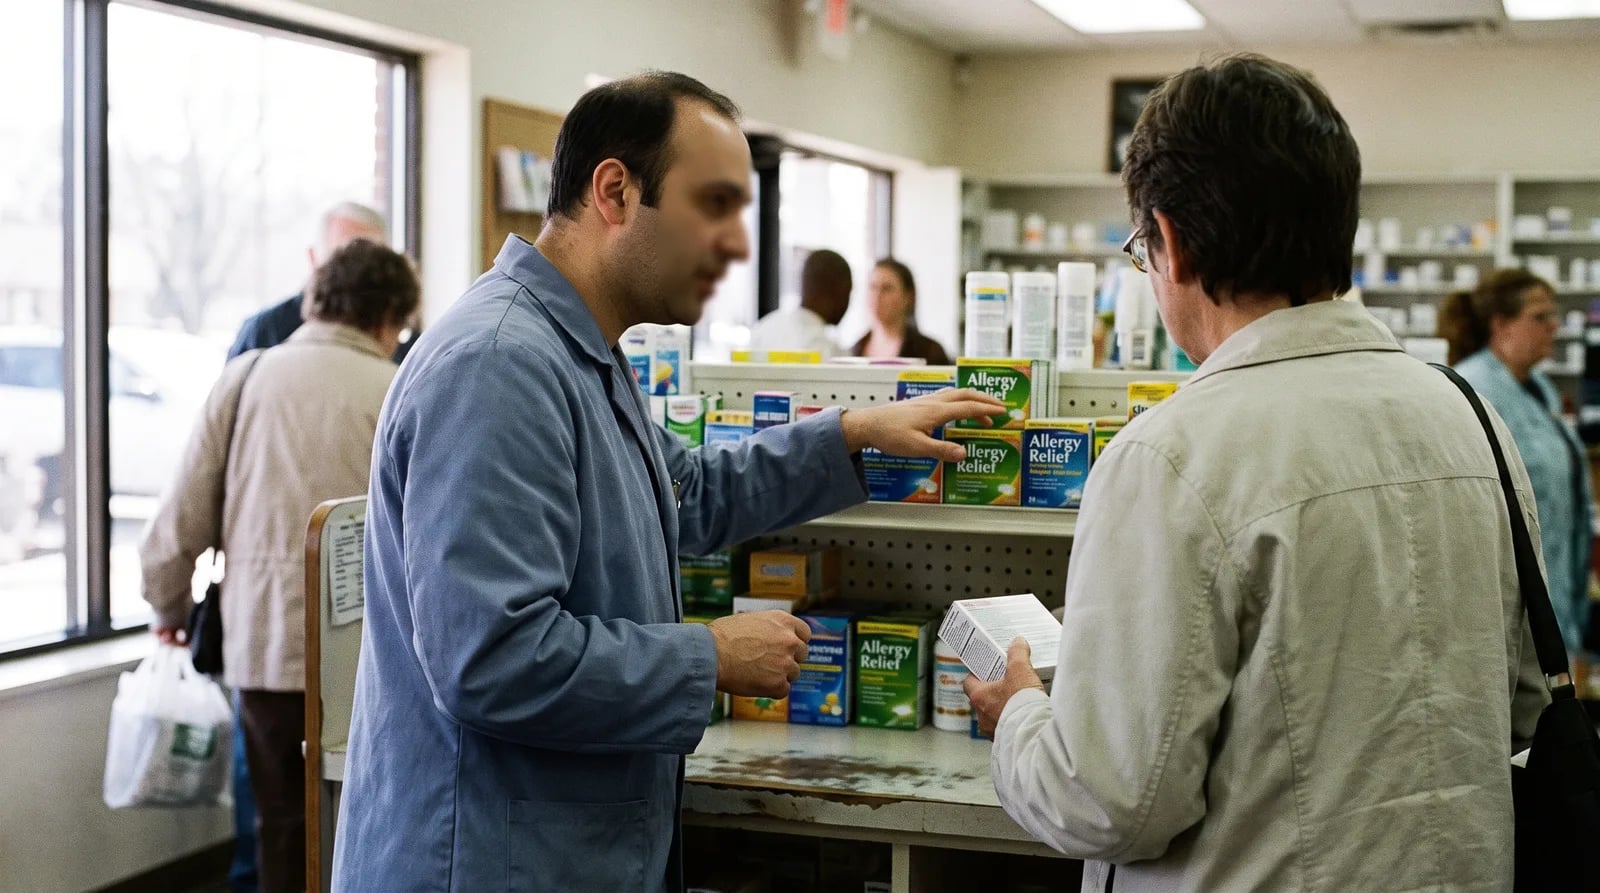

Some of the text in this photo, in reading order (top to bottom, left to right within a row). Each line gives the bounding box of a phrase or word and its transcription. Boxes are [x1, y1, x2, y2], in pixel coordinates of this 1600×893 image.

[967, 372, 1018, 391] Allergy
[968, 387, 1007, 401] lief
[1029, 433, 1082, 453] Allergy
[962, 443, 1008, 464] llergy
[1029, 448, 1070, 464] Relief
[956, 458, 997, 474] Relief
[860, 639, 912, 660] Allergy
[860, 655, 902, 670] Relief
